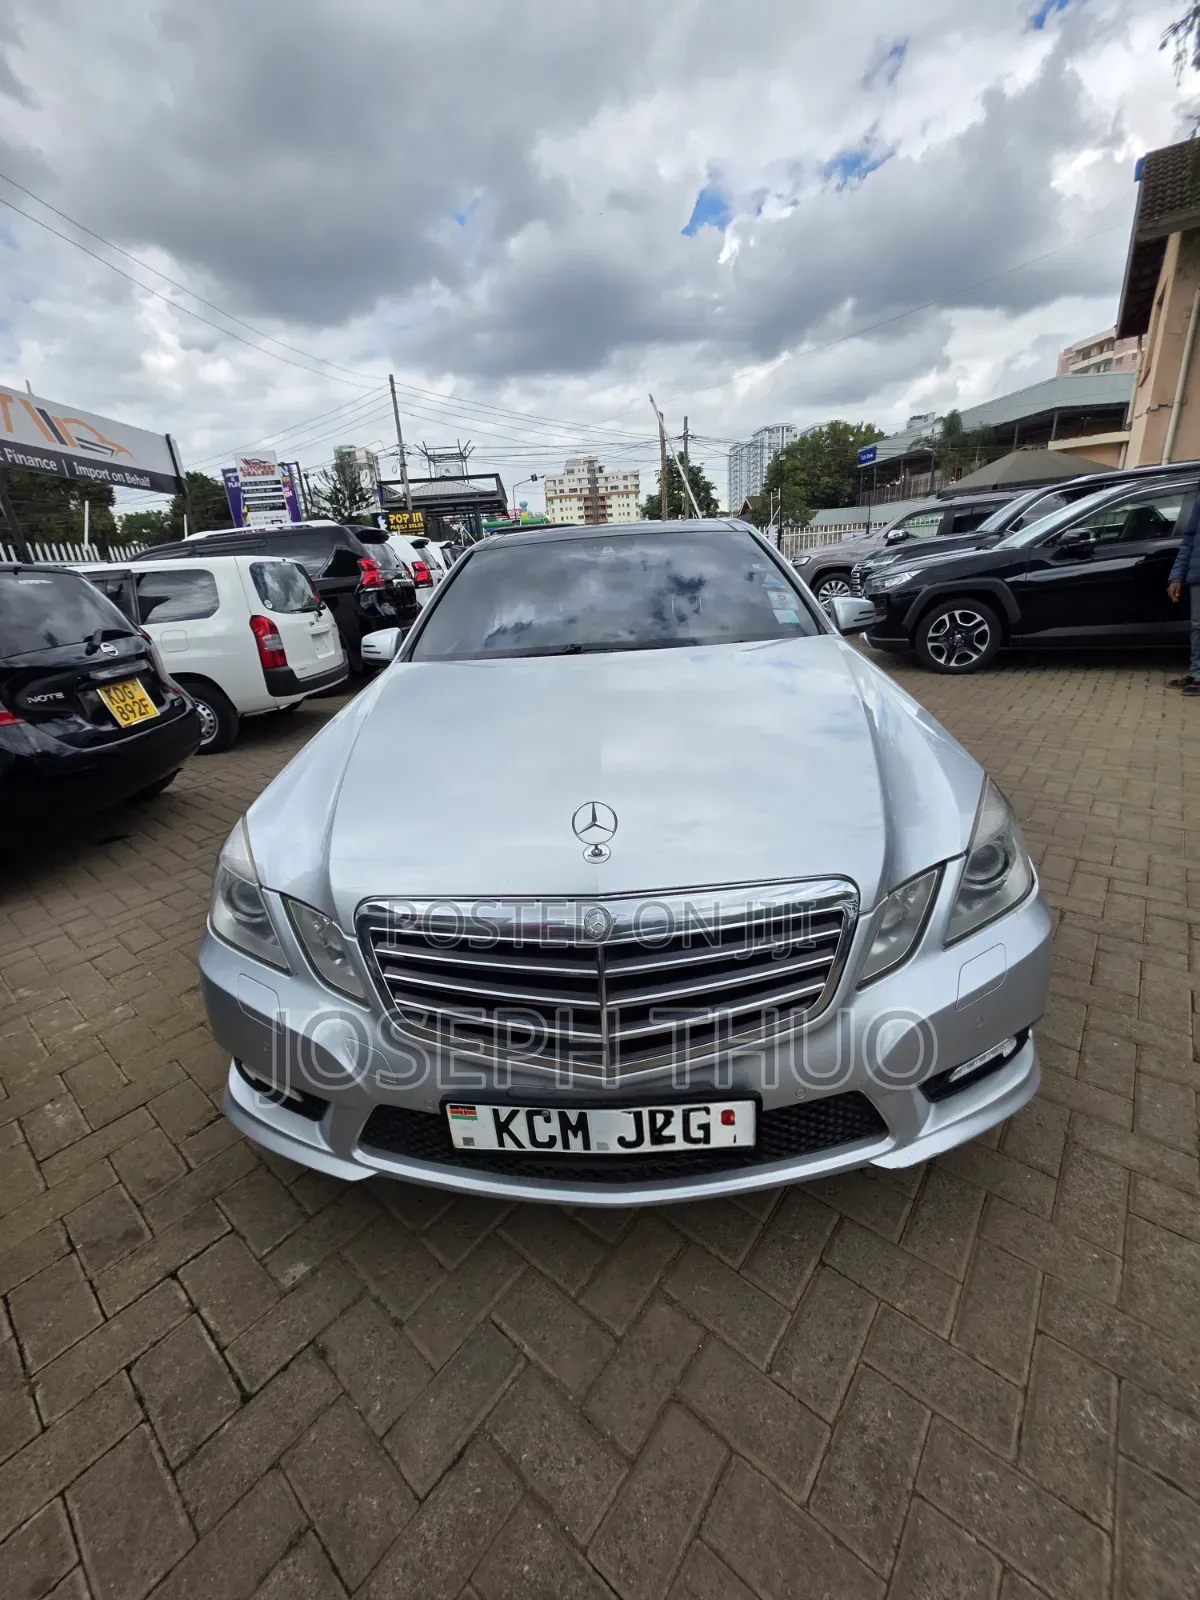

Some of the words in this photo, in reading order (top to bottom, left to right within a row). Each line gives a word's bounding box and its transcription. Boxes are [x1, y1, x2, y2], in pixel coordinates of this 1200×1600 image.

[4, 447, 58, 471] Finance
[73, 462, 111, 480] Import
[113, 471, 125, 483] on
[126, 473, 151, 487] Behalf
[388, 513, 410, 524] POP
[412, 512, 423, 522] IN
[26, 691, 65, 704] NOTE
[103, 685, 136, 706] KDG
[117, 698, 150, 722] 892F
[492, 1107, 592, 1150] KCM
